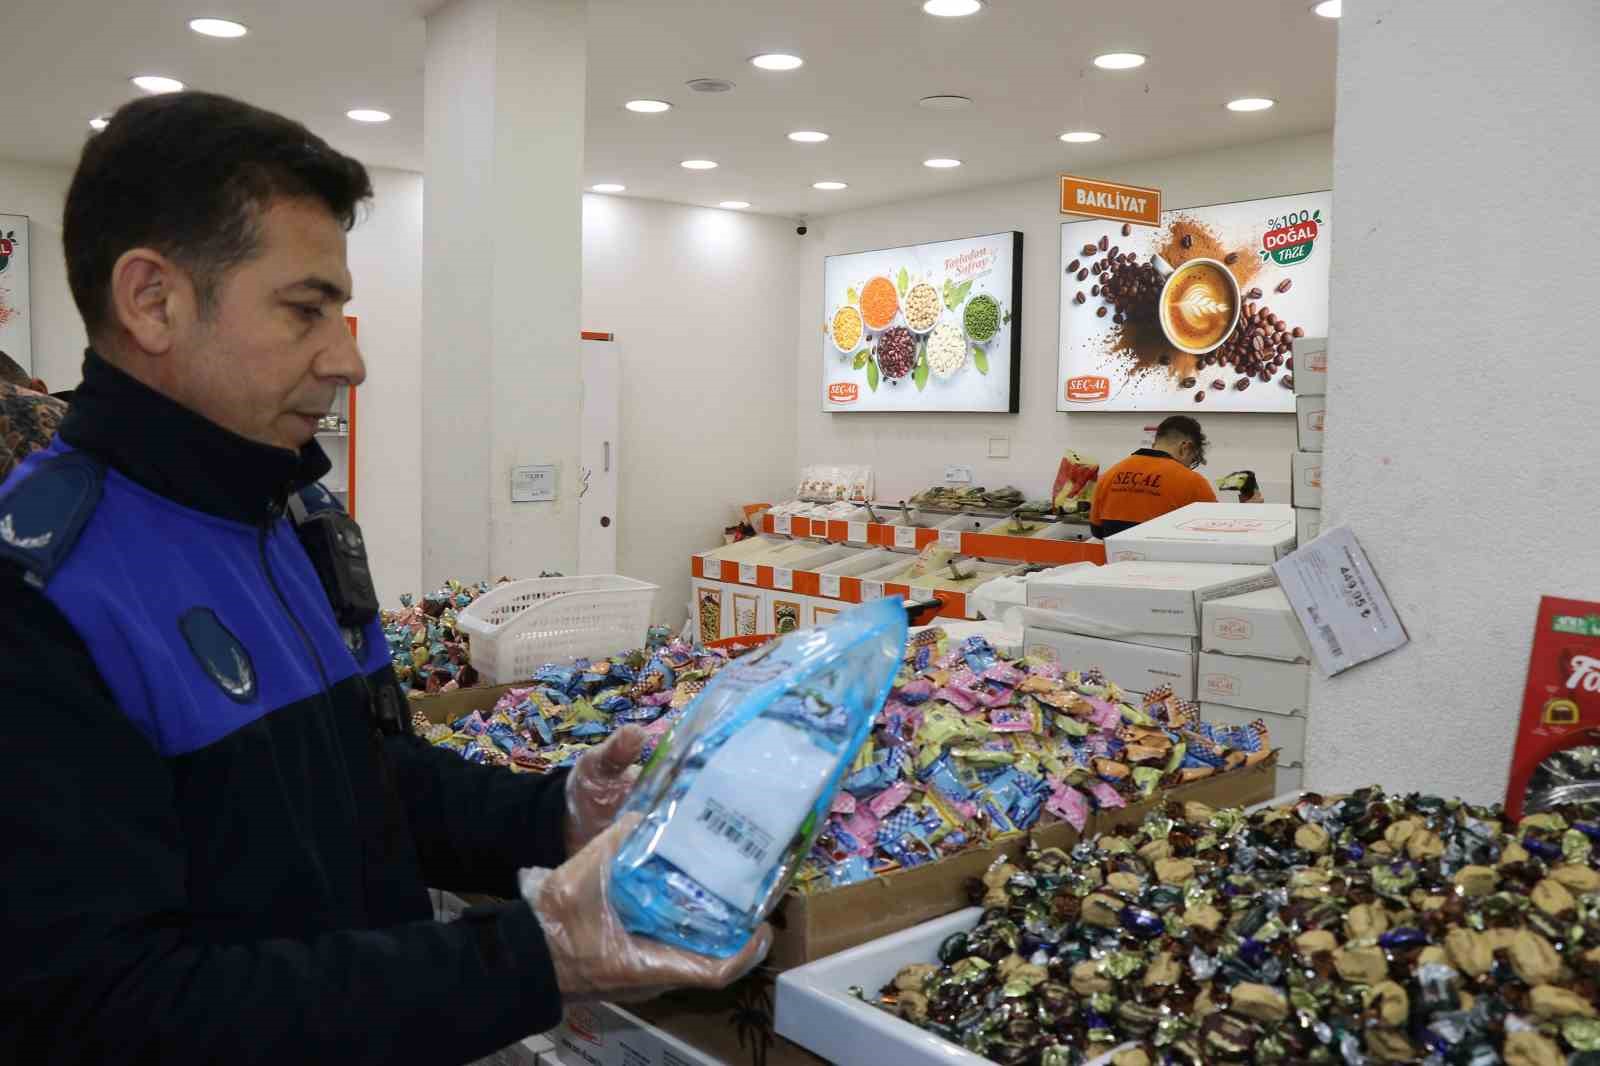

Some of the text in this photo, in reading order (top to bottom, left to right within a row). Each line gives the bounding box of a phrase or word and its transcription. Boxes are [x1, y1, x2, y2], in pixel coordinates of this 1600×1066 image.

[1076, 189, 1146, 214] BAKLİYAT
[1267, 210, 1309, 231] %100
[1266, 227, 1315, 248] DOĞAL
